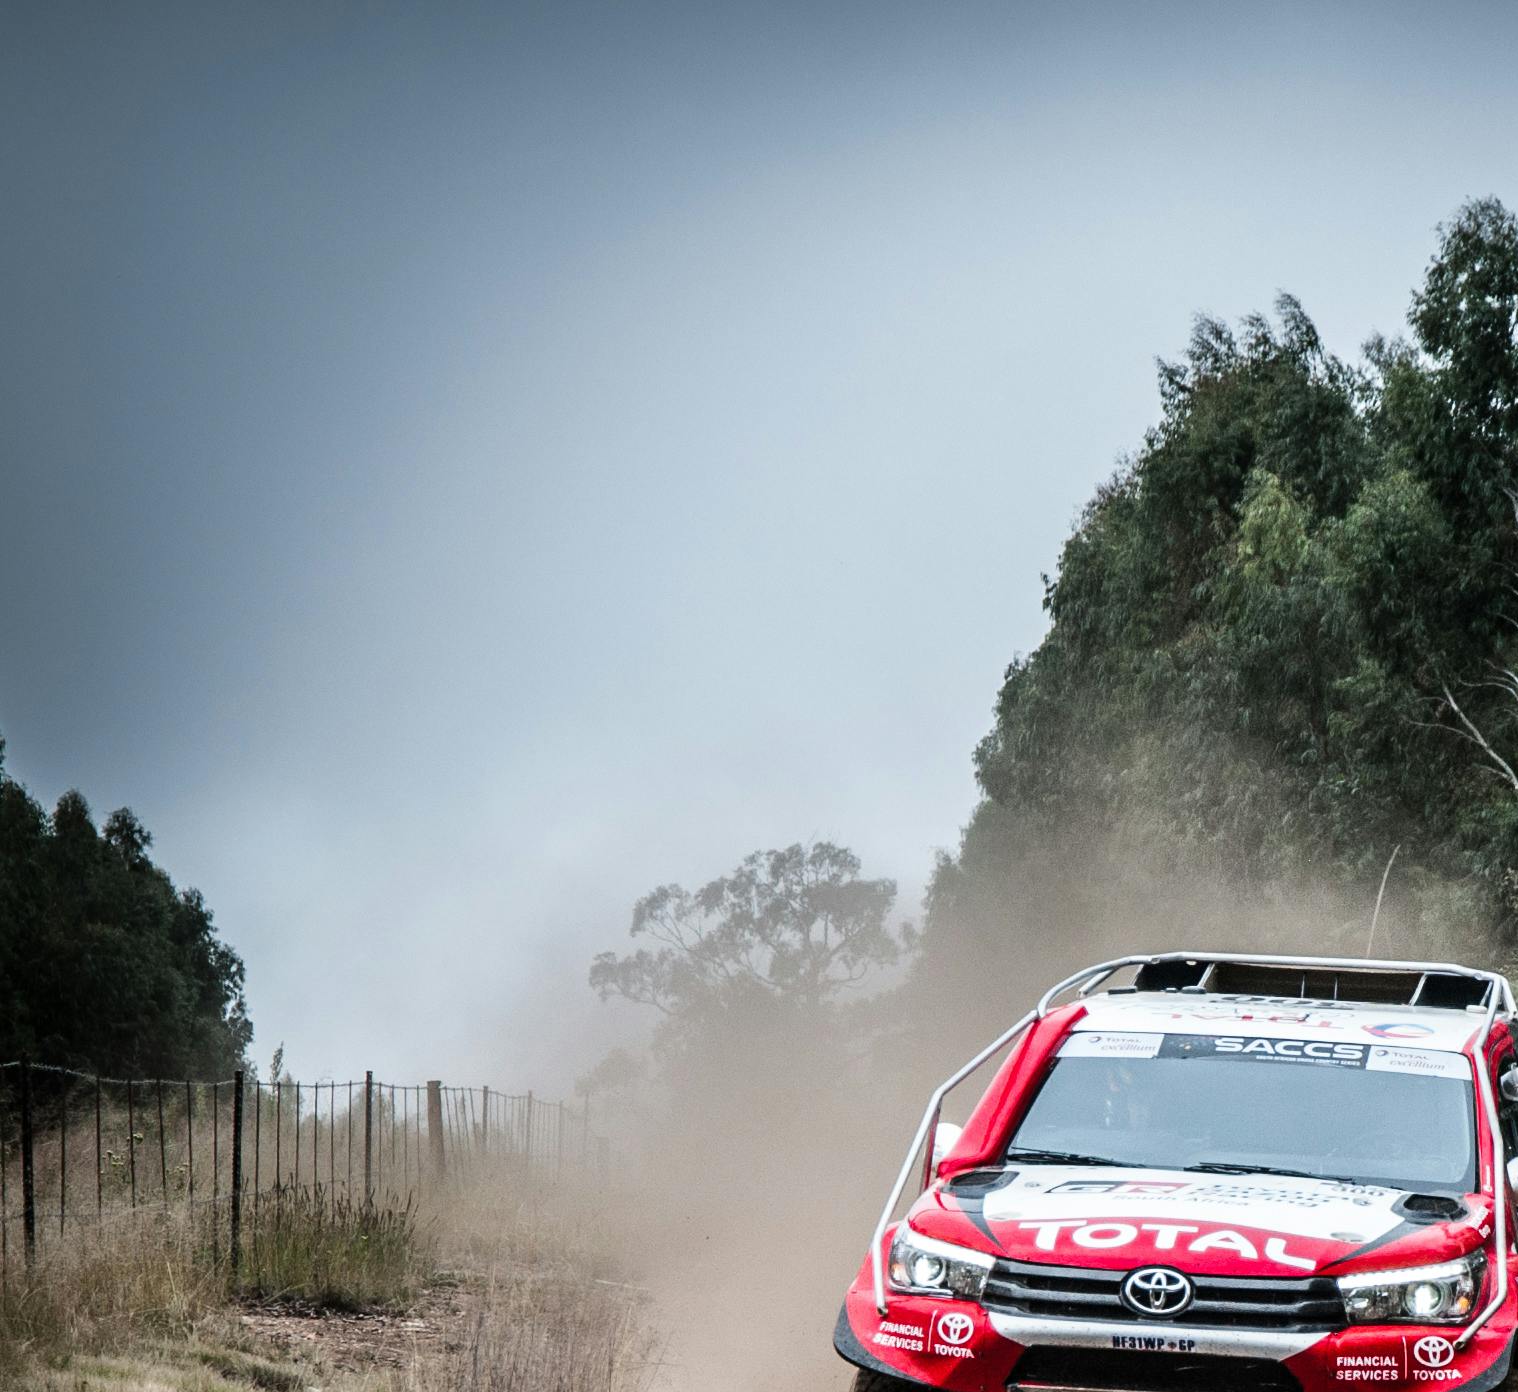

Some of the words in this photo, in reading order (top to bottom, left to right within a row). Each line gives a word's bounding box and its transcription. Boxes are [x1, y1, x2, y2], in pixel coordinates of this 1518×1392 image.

[1214, 1037, 1364, 1060] SACCS
[1018, 1219, 1317, 1271] TOTAL
[880, 1321, 925, 1338] FINANCIAL
[873, 1333, 924, 1352] SERVICES
[934, 1344, 975, 1359] TOYOTA
[1336, 1356, 1399, 1367] FINANCIAL
[1336, 1370, 1399, 1381] SERVICES
[1412, 1369, 1463, 1381] TOYOTA
